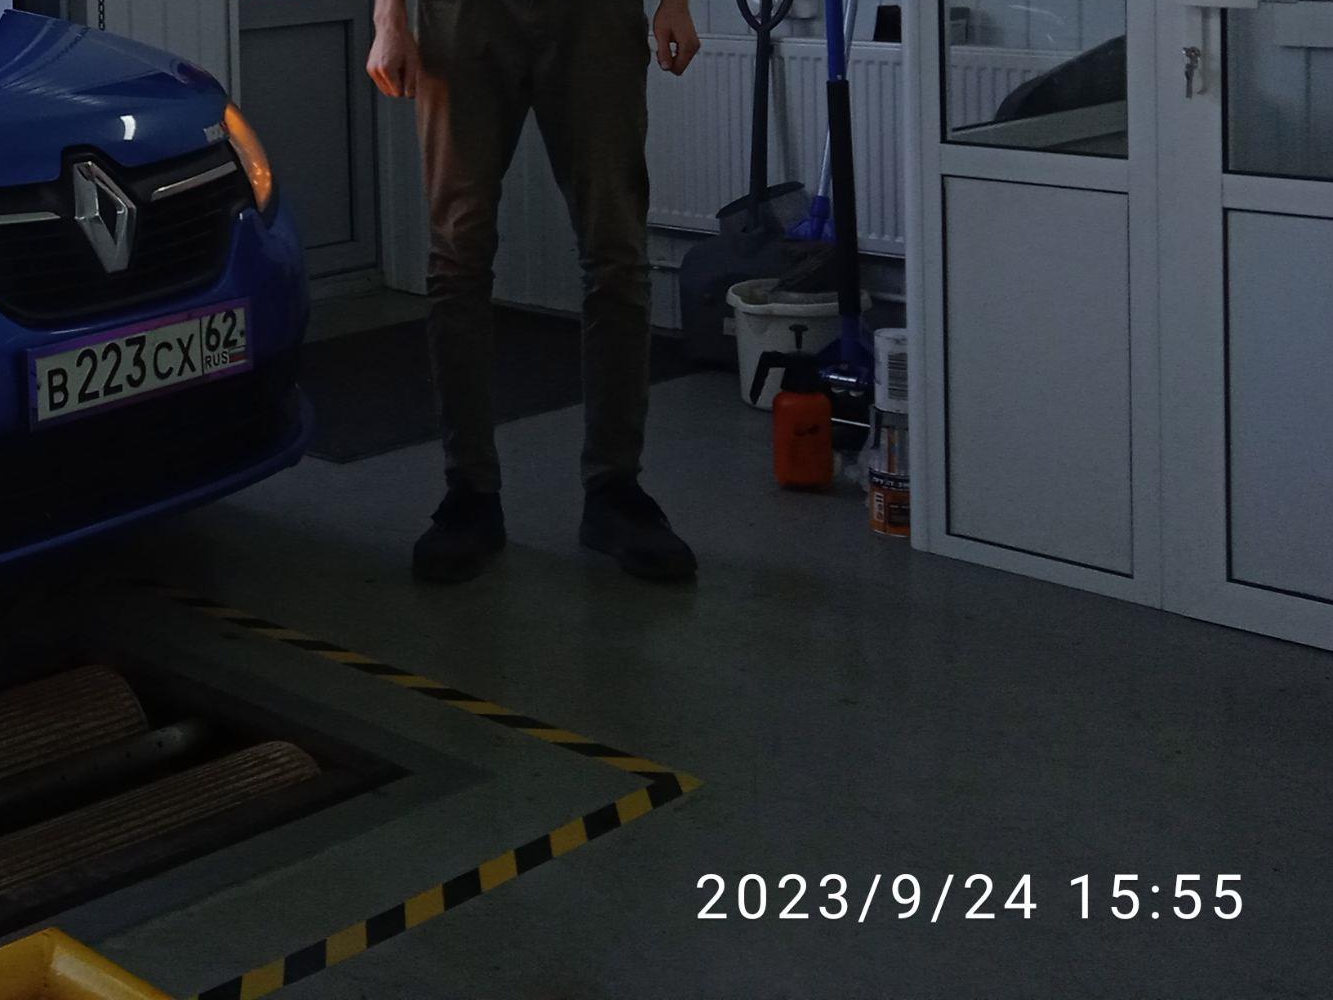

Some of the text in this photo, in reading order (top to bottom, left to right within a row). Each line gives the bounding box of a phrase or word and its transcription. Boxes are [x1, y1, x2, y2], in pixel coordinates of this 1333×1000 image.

[48, 310, 238, 412] В223СХ 62
[205, 351, 230, 369] RUS
